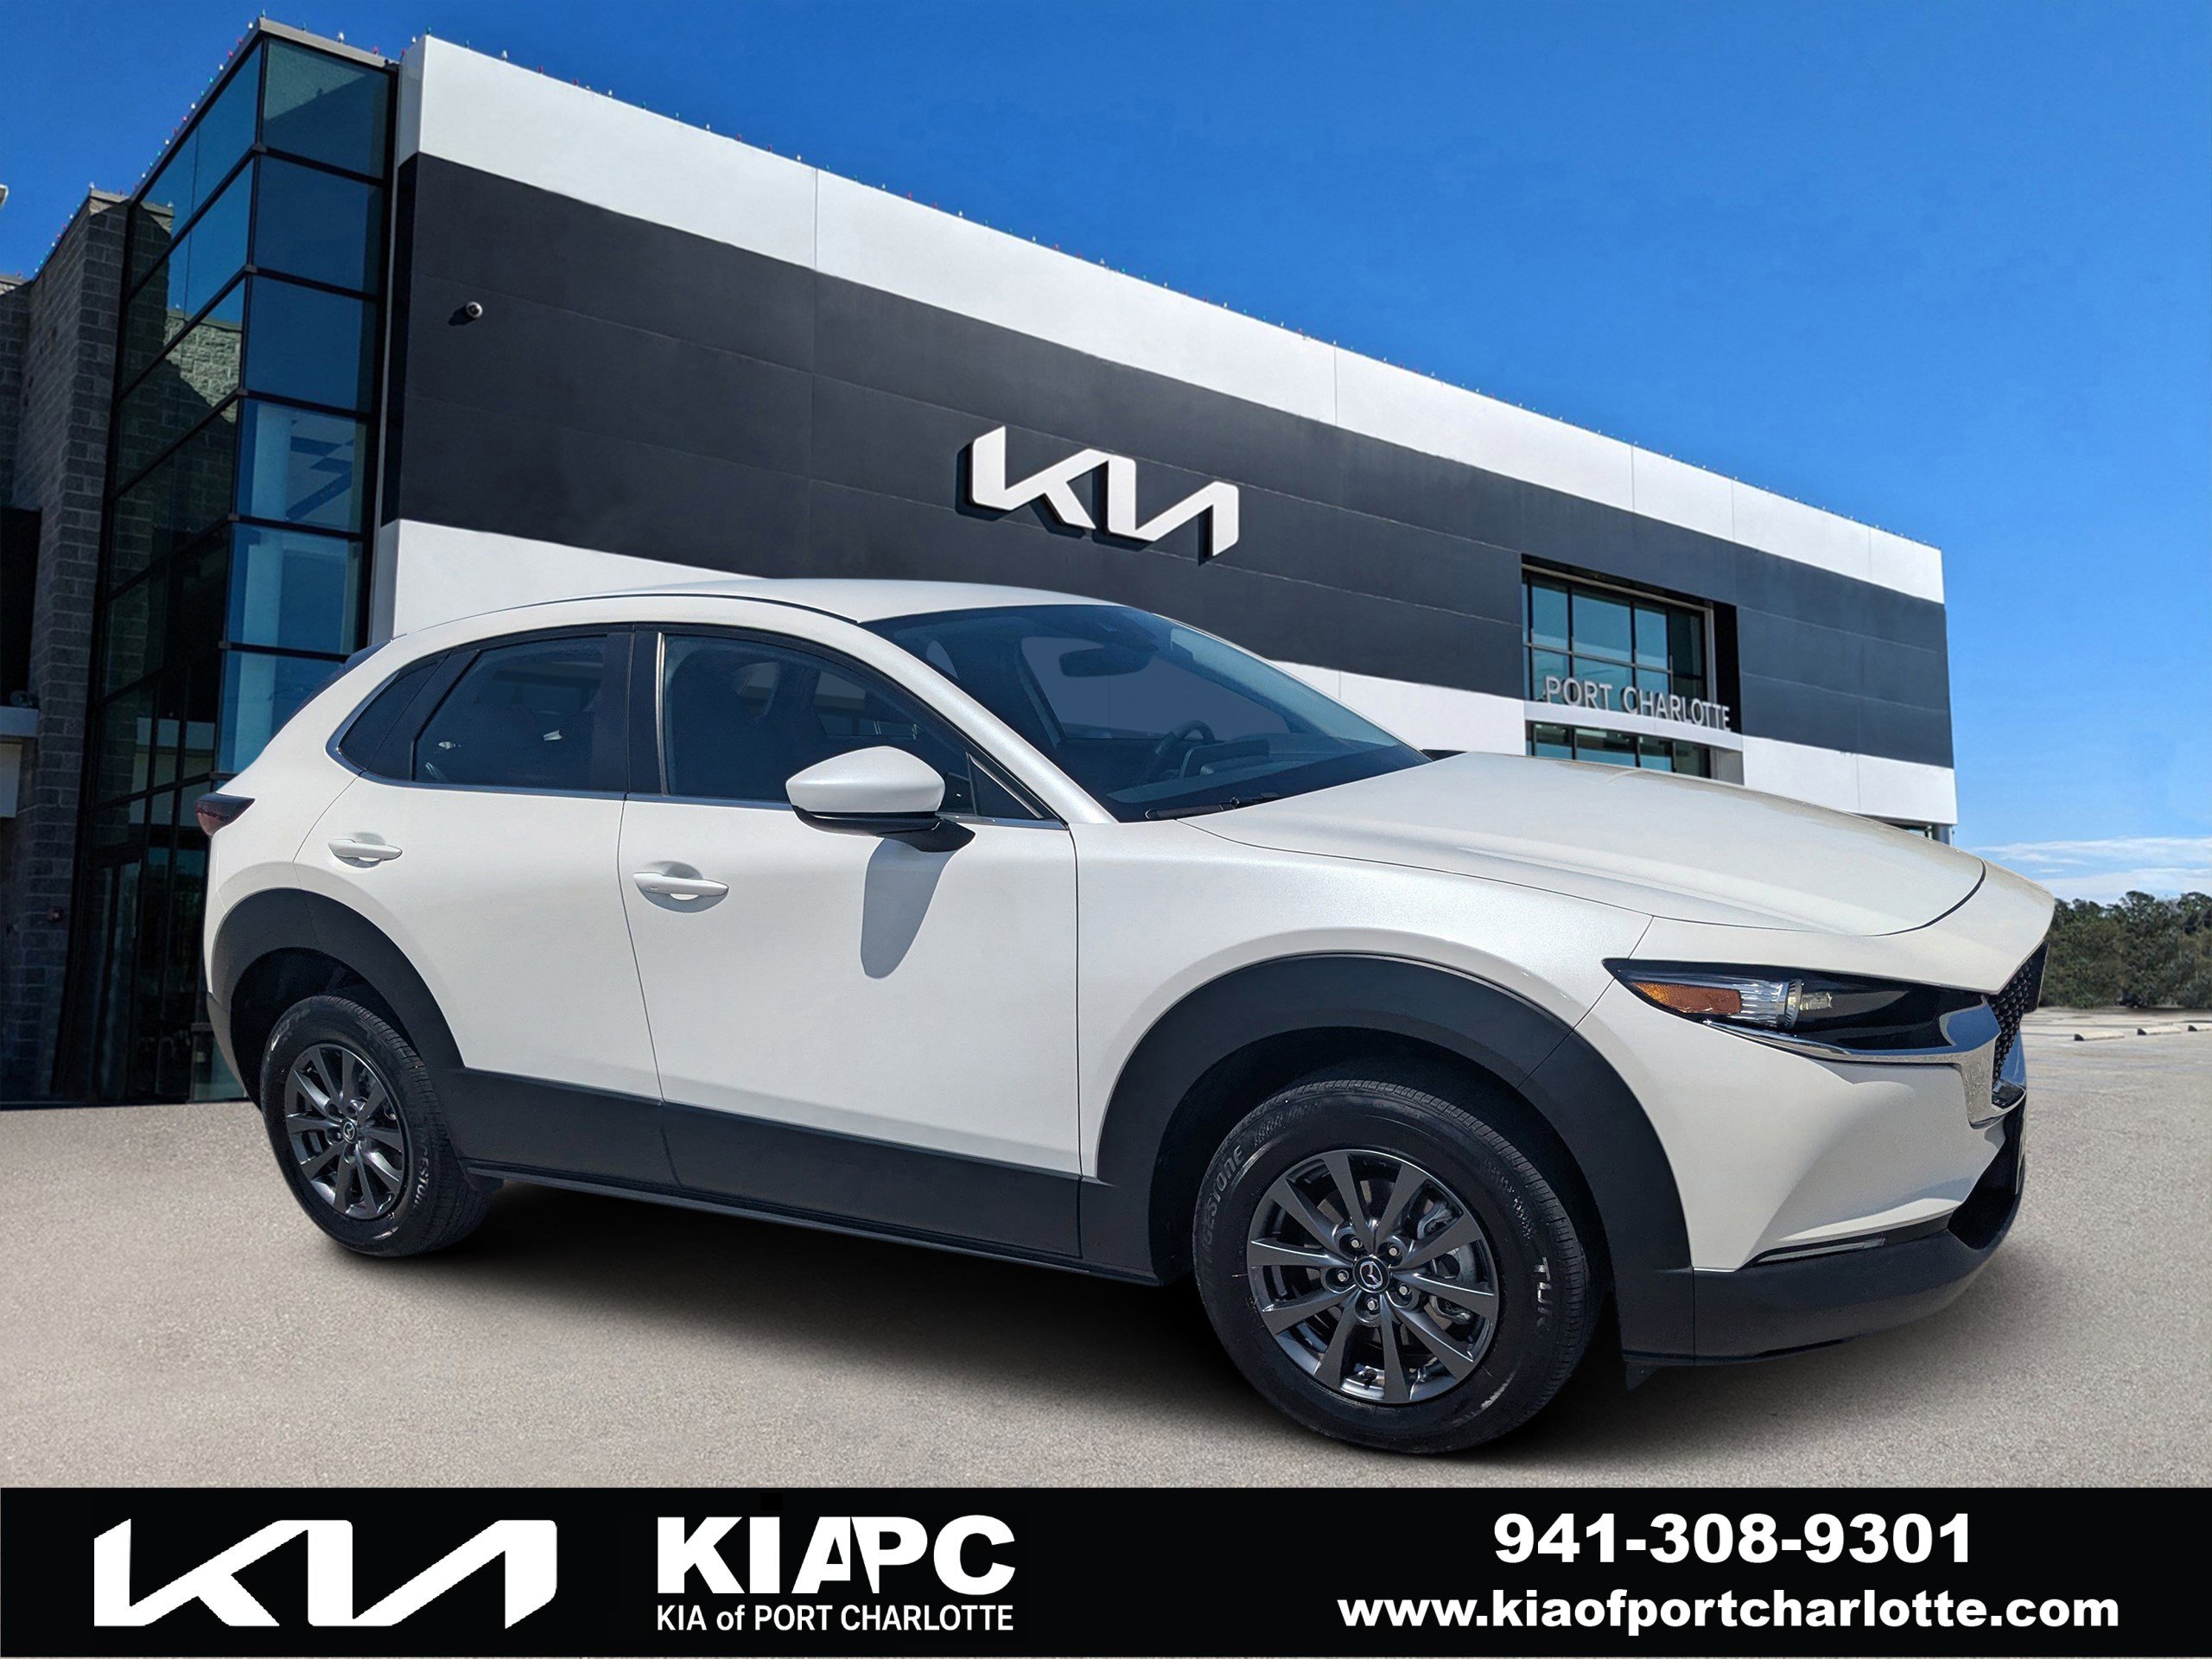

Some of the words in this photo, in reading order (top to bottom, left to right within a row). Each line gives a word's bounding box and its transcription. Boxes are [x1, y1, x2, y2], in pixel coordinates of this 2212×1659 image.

[972, 425, 1239, 556] KIA
[1543, 676, 1612, 711] PORT
[1622, 686, 1732, 732] CHARLOTTE
